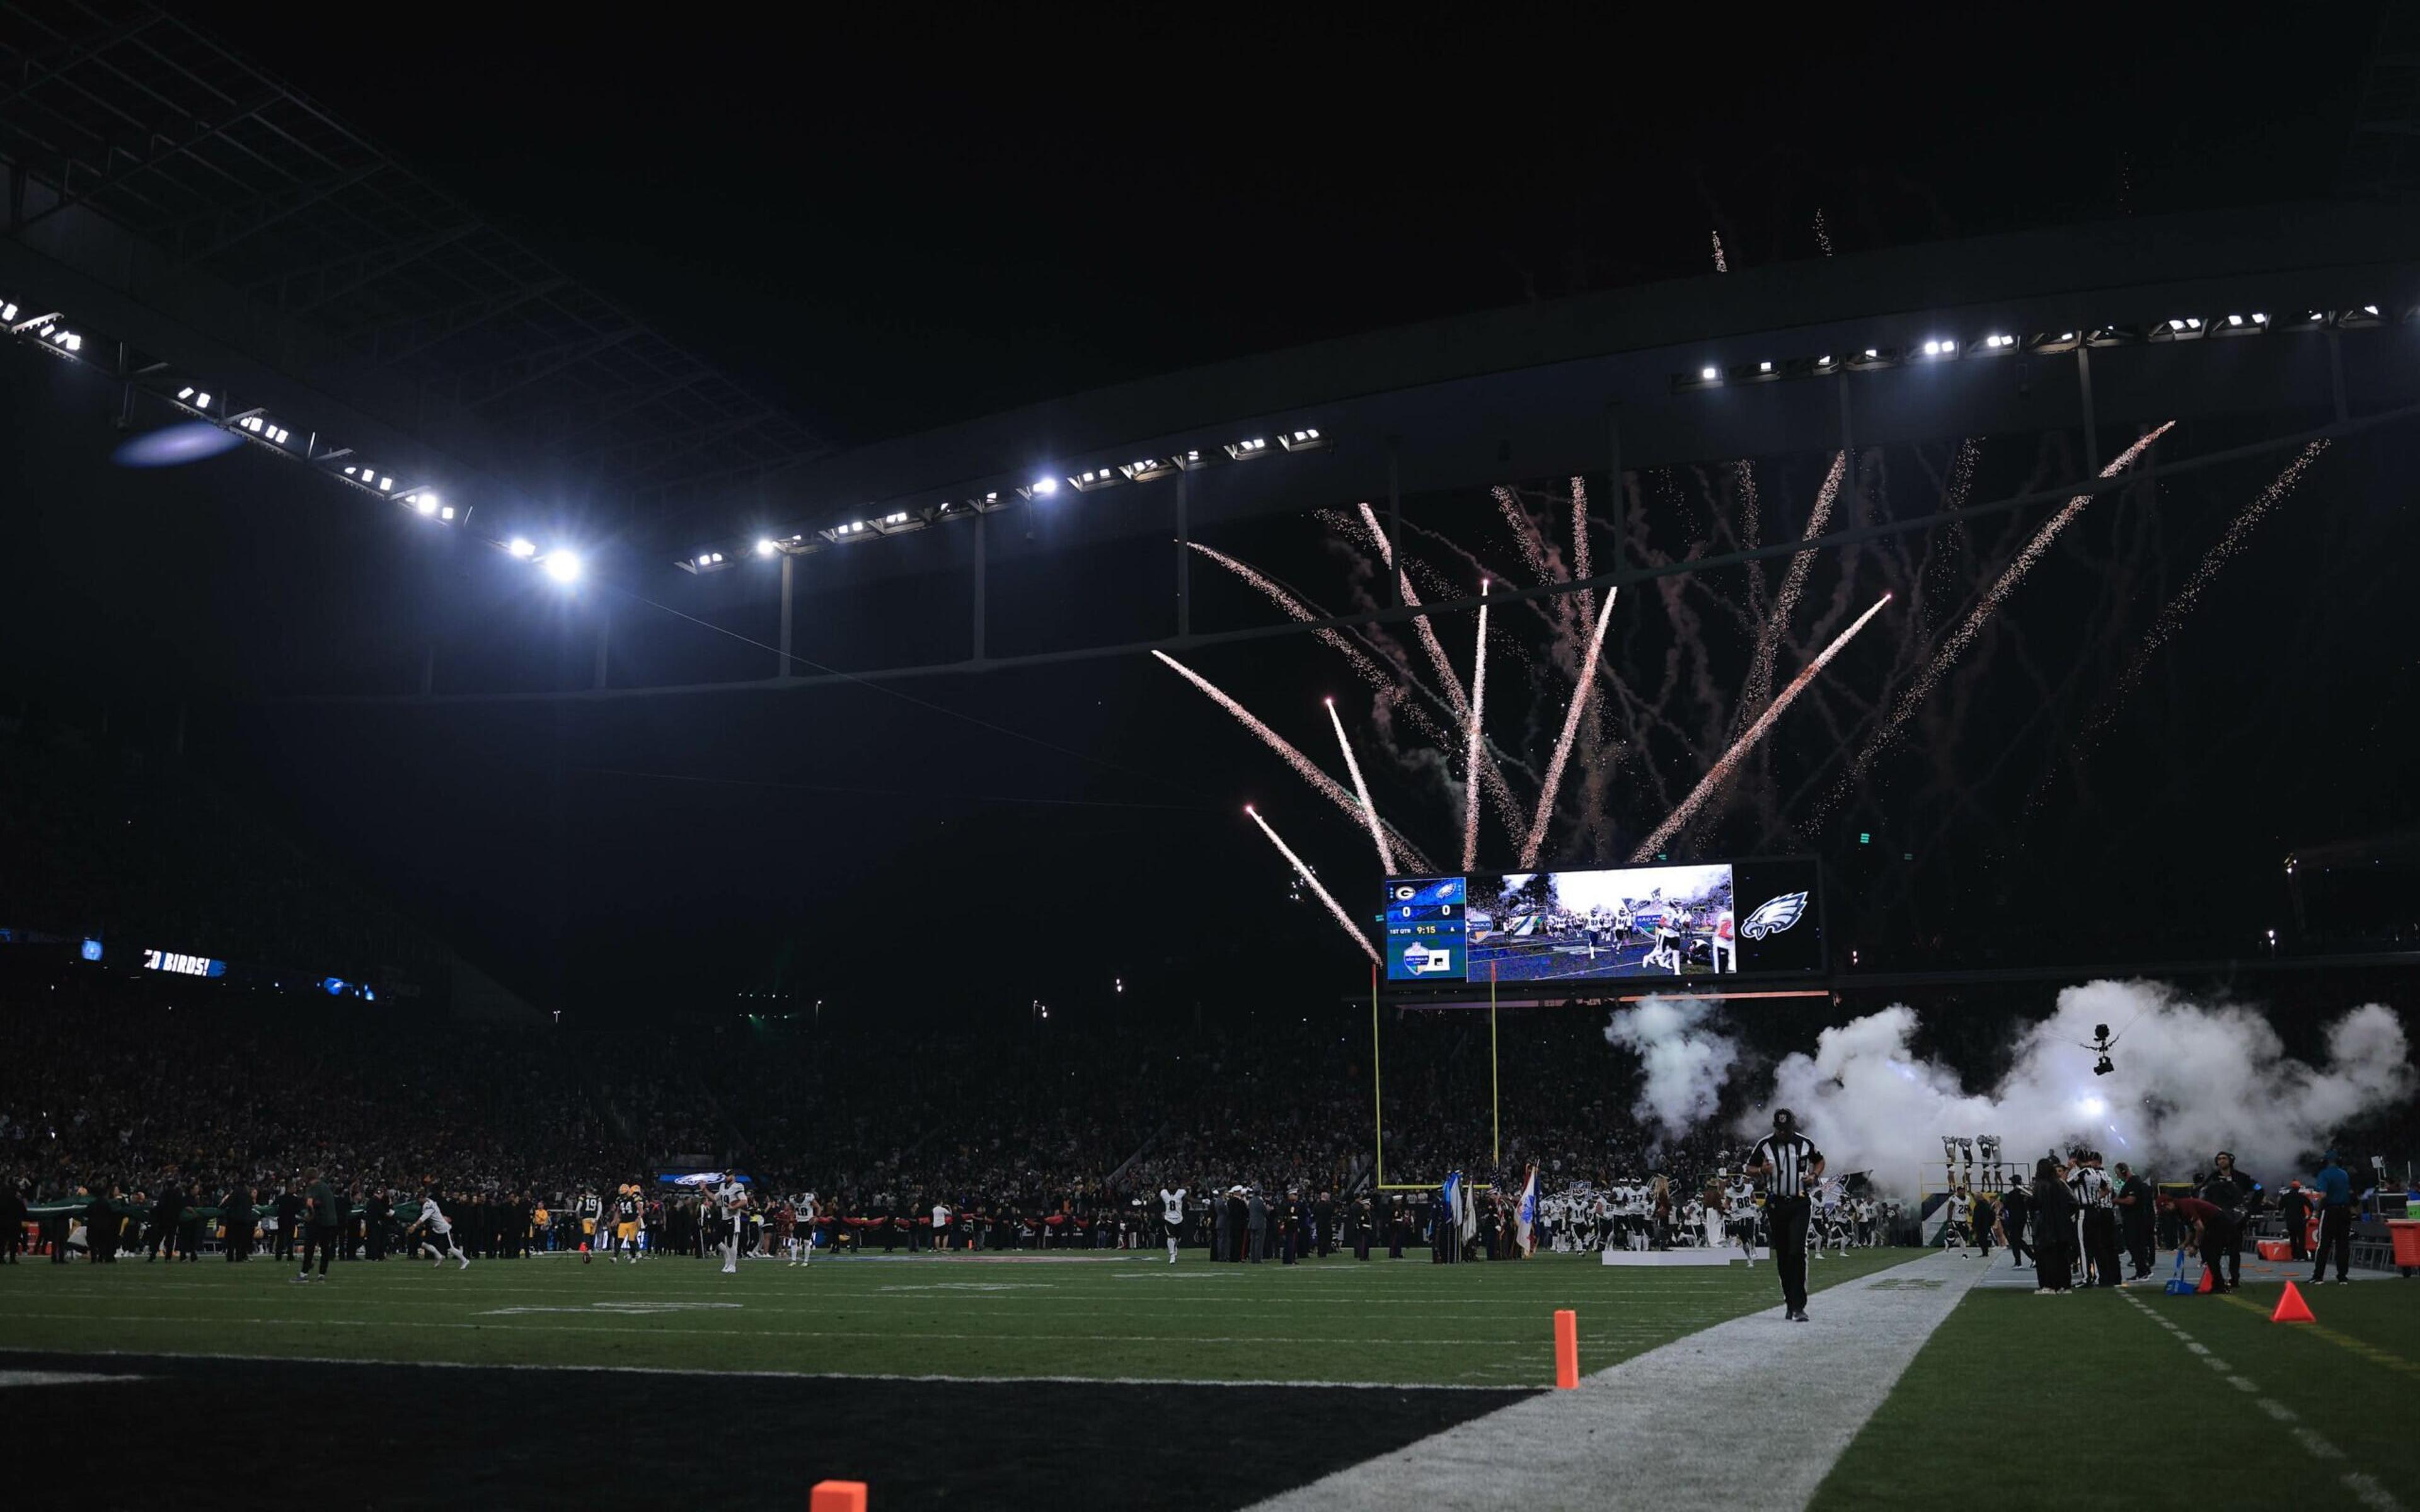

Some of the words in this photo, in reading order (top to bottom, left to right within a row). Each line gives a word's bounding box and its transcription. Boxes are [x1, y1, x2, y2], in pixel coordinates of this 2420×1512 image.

[1402, 907, 1410, 917] 0
[1442, 905, 1450, 915] 0
[1417, 926, 1436, 934] 9:15
[162, 953, 210, 977] BIRDS!
[585, 1198, 597, 1211] 19
[619, 1201, 633, 1214] 44
[1170, 1201, 1175, 1211] 8
